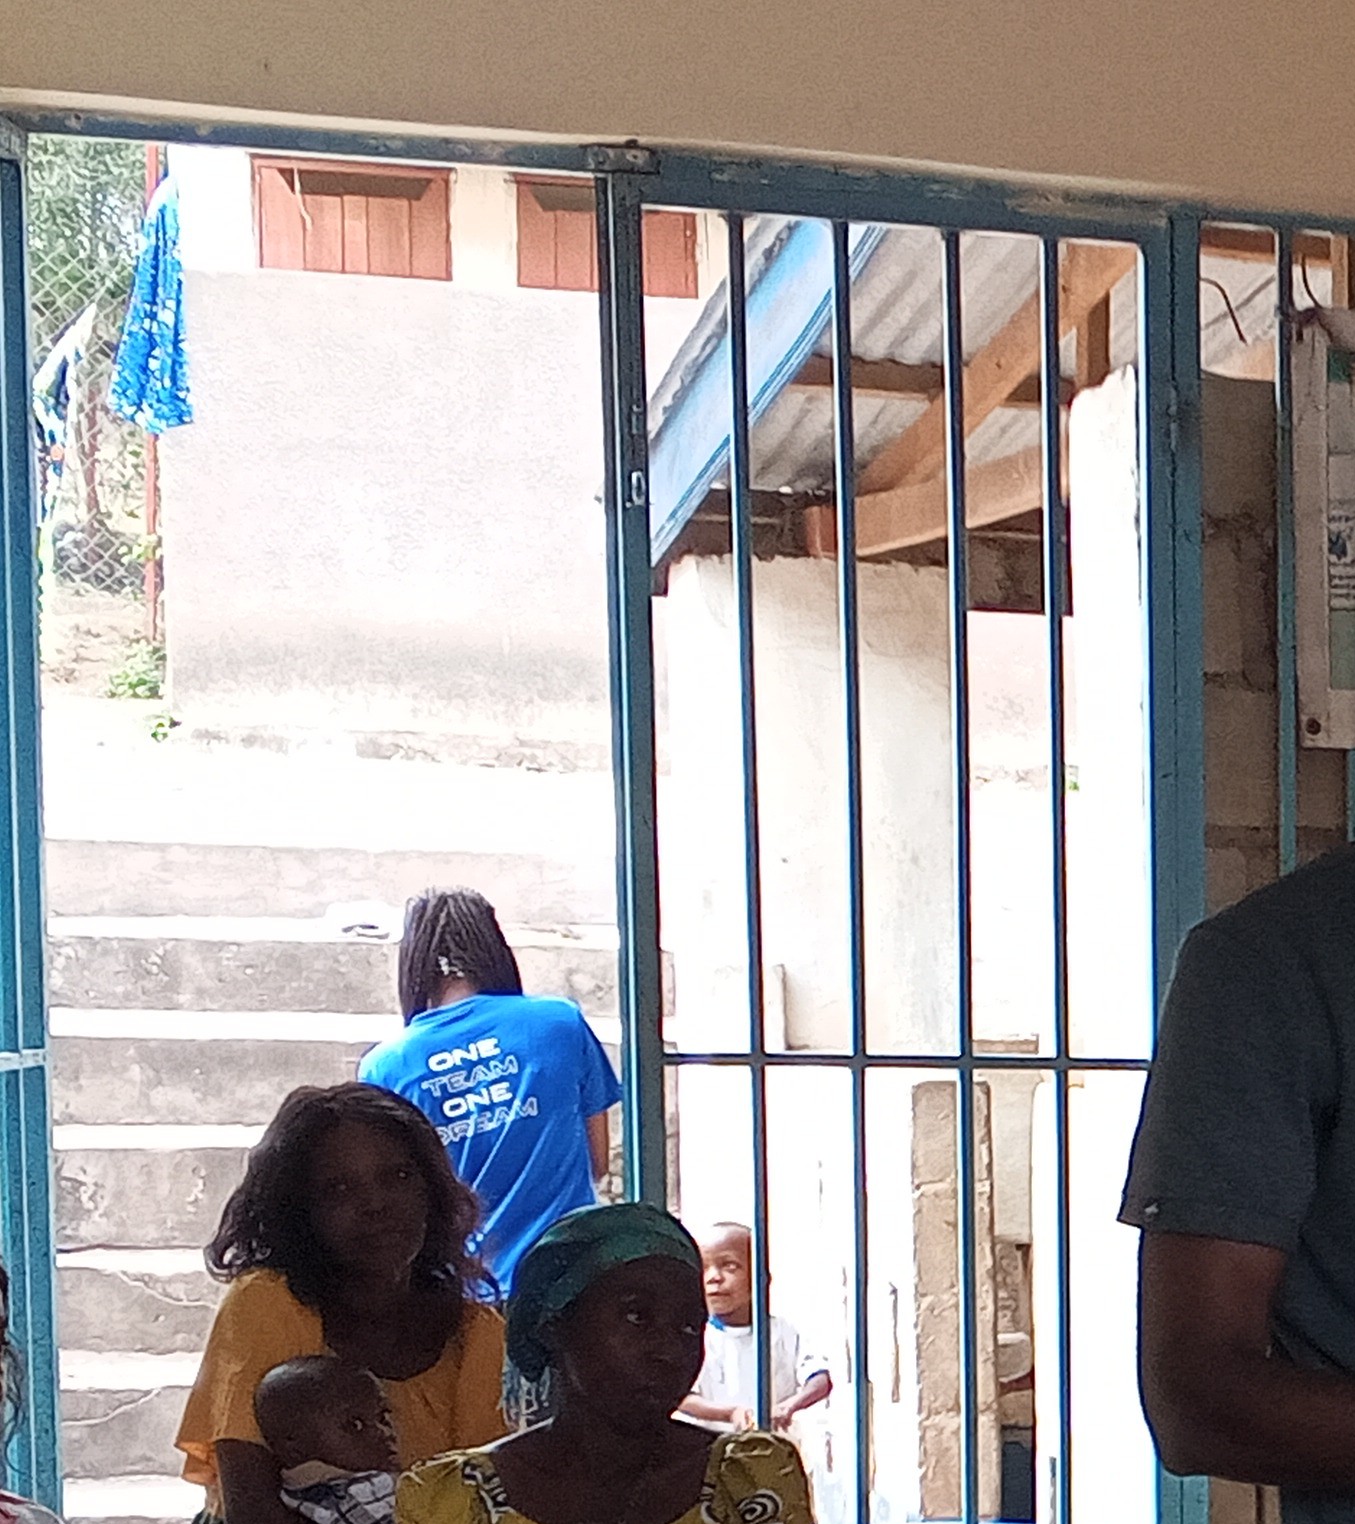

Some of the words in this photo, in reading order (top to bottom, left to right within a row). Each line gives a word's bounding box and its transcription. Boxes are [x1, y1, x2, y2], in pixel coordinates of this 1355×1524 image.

[428, 1037, 501, 1072] ONE
[421, 1054, 519, 1097] TEAM
[442, 1081, 513, 1118] ONE
